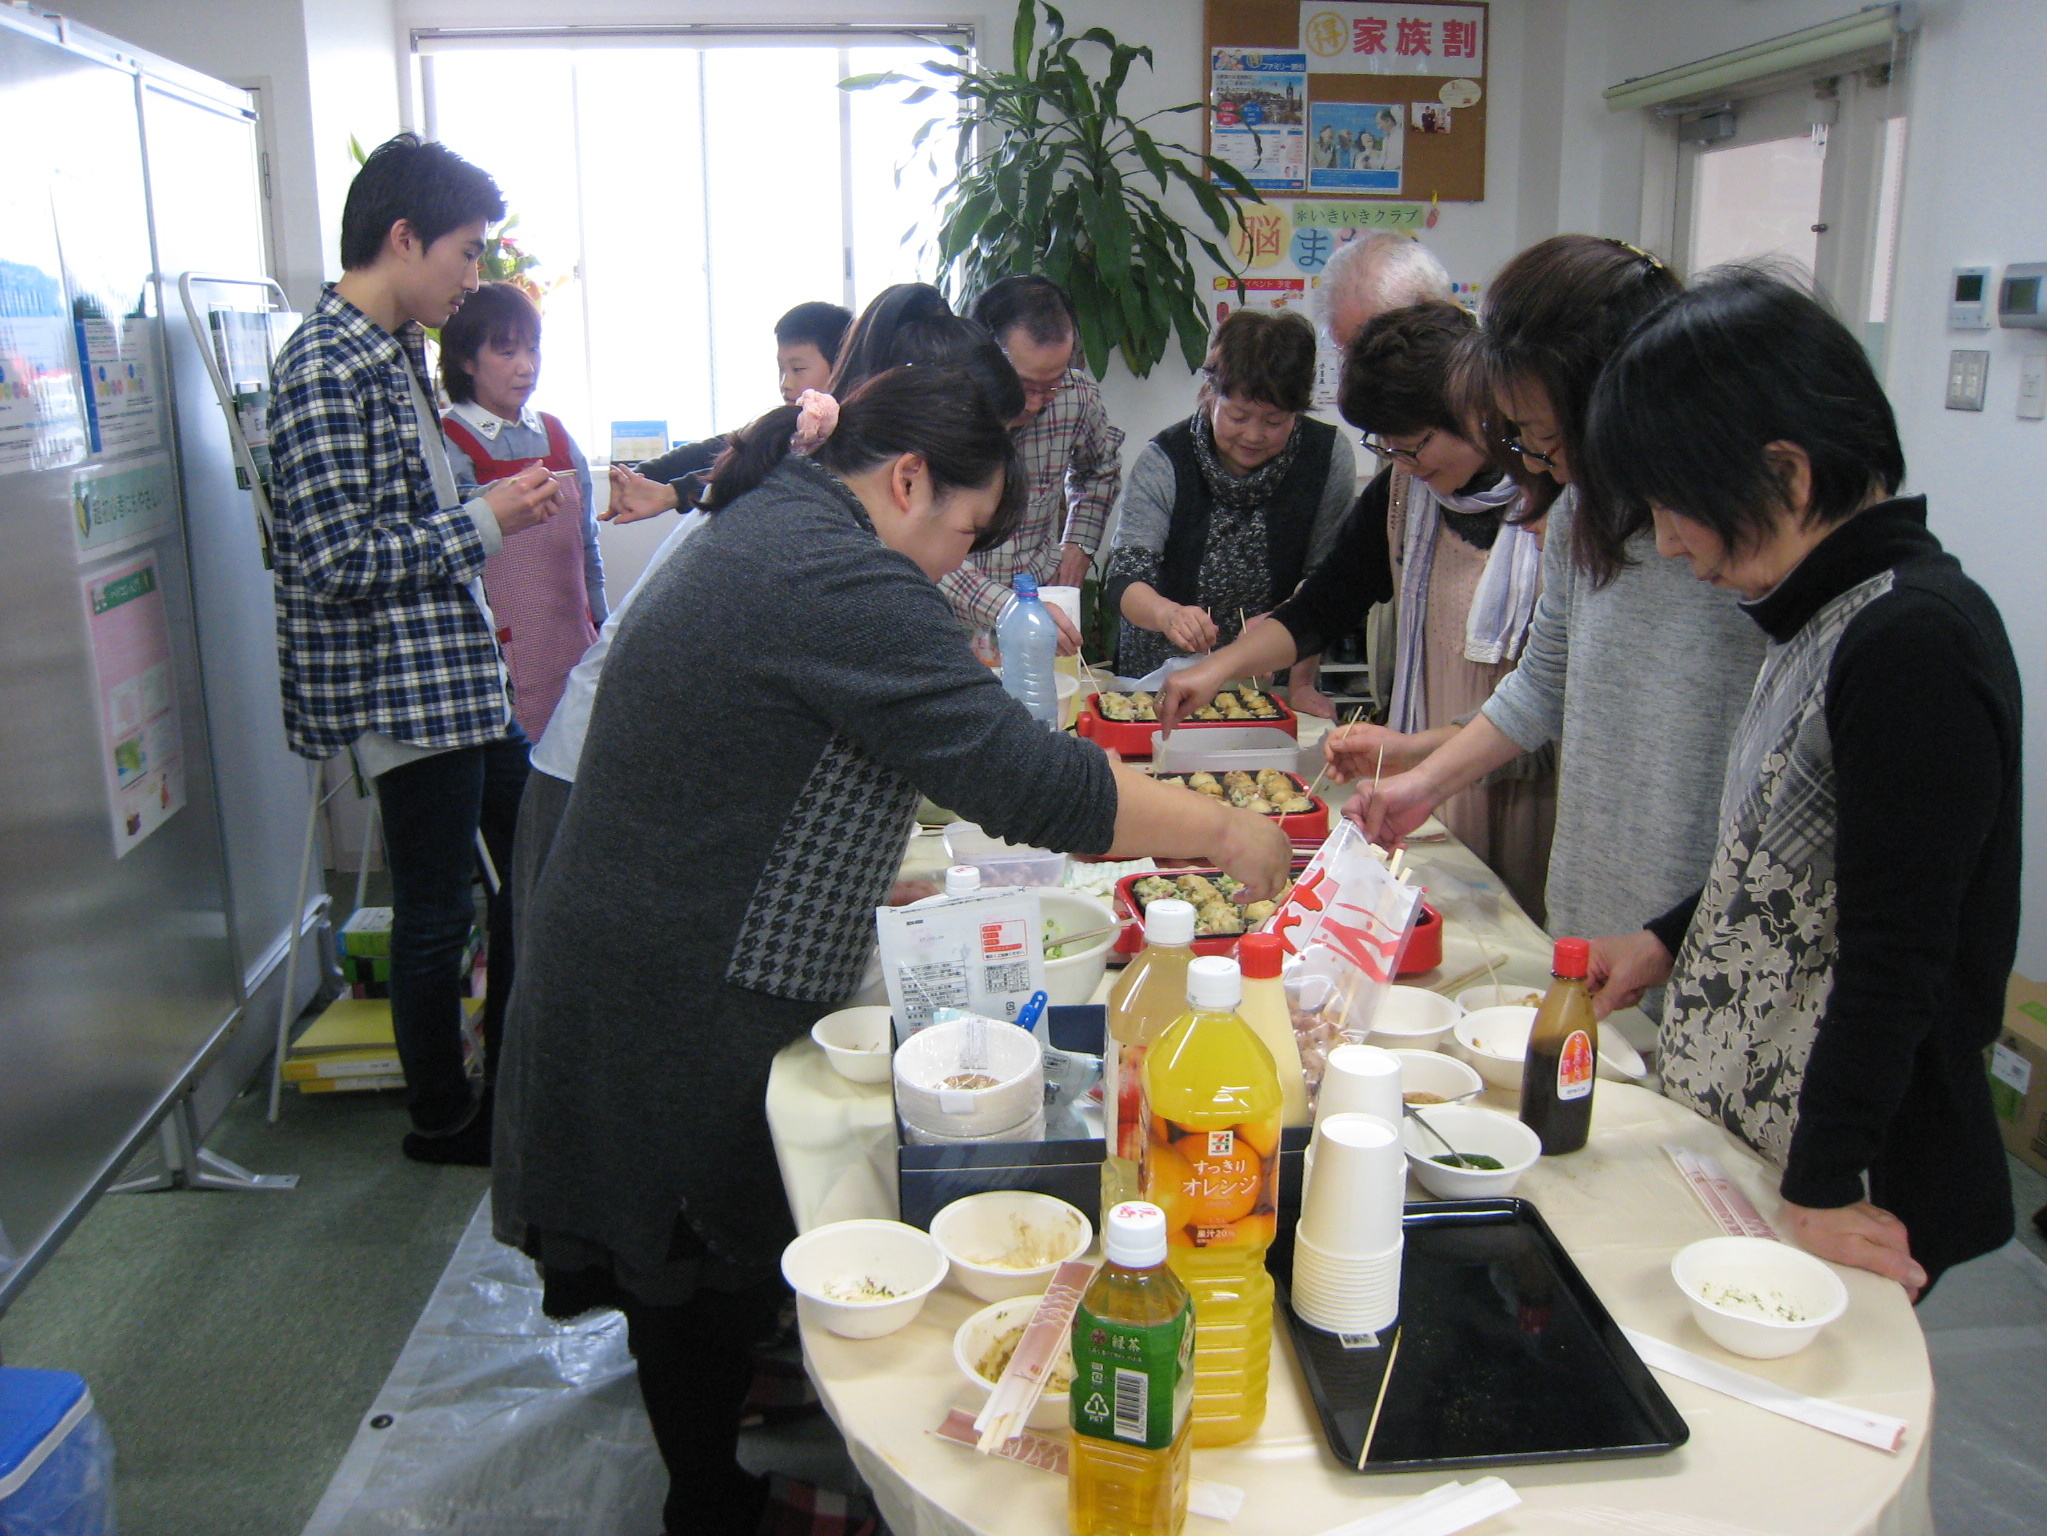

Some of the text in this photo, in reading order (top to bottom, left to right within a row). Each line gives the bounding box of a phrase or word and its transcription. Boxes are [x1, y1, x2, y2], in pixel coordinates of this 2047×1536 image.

[1352, 17, 1477, 58] 家族割
[1194, 1160, 1247, 1175] すっきり
[1183, 1176, 1258, 1197] オレンジ
[1112, 1334, 1140, 1352] 緑茶
